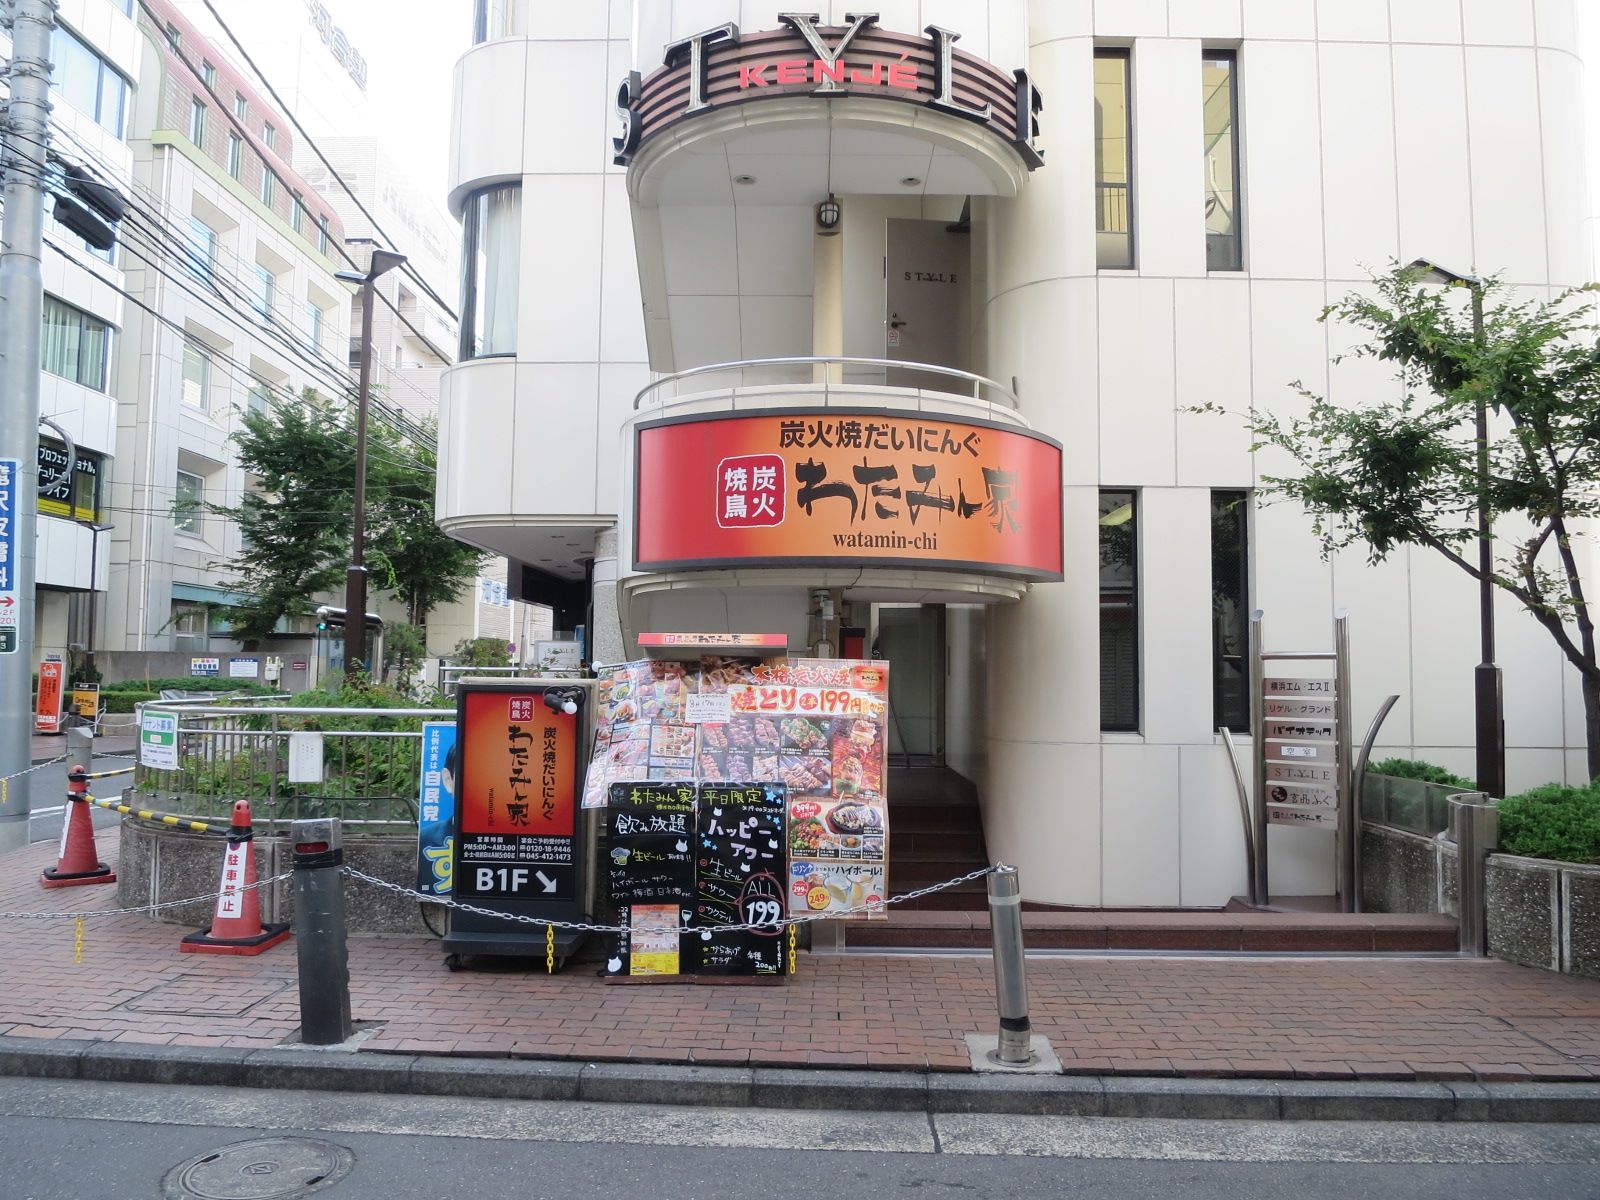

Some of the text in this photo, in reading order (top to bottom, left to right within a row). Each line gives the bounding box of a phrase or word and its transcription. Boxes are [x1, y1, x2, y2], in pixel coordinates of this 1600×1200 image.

[739, 52, 919, 90] KENJÉ
[612, 12, 1045, 171] STYLE
[904, 271, 958, 283] STYLE
[779, 420, 983, 458] 炭火焼だいにんぐ
[39, 447, 96, 474] プロフェッョナル。
[795, 456, 1021, 533] わたみん家
[833, 530, 937, 551] watamin-chi
[506, 725, 534, 827] わたみん家
[541, 726, 557, 822] 炭火焼だいにんぐ
[1274, 767, 1331, 781] STYLE
[423, 770, 441, 822] 自民党
[702, 787, 762, 806] 平日限定
[615, 813, 687, 835] 飲み放題
[708, 816, 772, 840] ハッピー
[526, 845, 571, 853] 0120-18-9446
[526, 852, 571, 861] 045-412-1473
[632, 847, 666, 862] 生ビール
[730, 842, 774, 860] アワー
[476, 868, 529, 892] B1F
[709, 857, 743, 881] 生ビール
[222, 854, 239, 912] 駐車禁止
[707, 883, 737, 900] サワー
[747, 880, 776, 898] ALL
